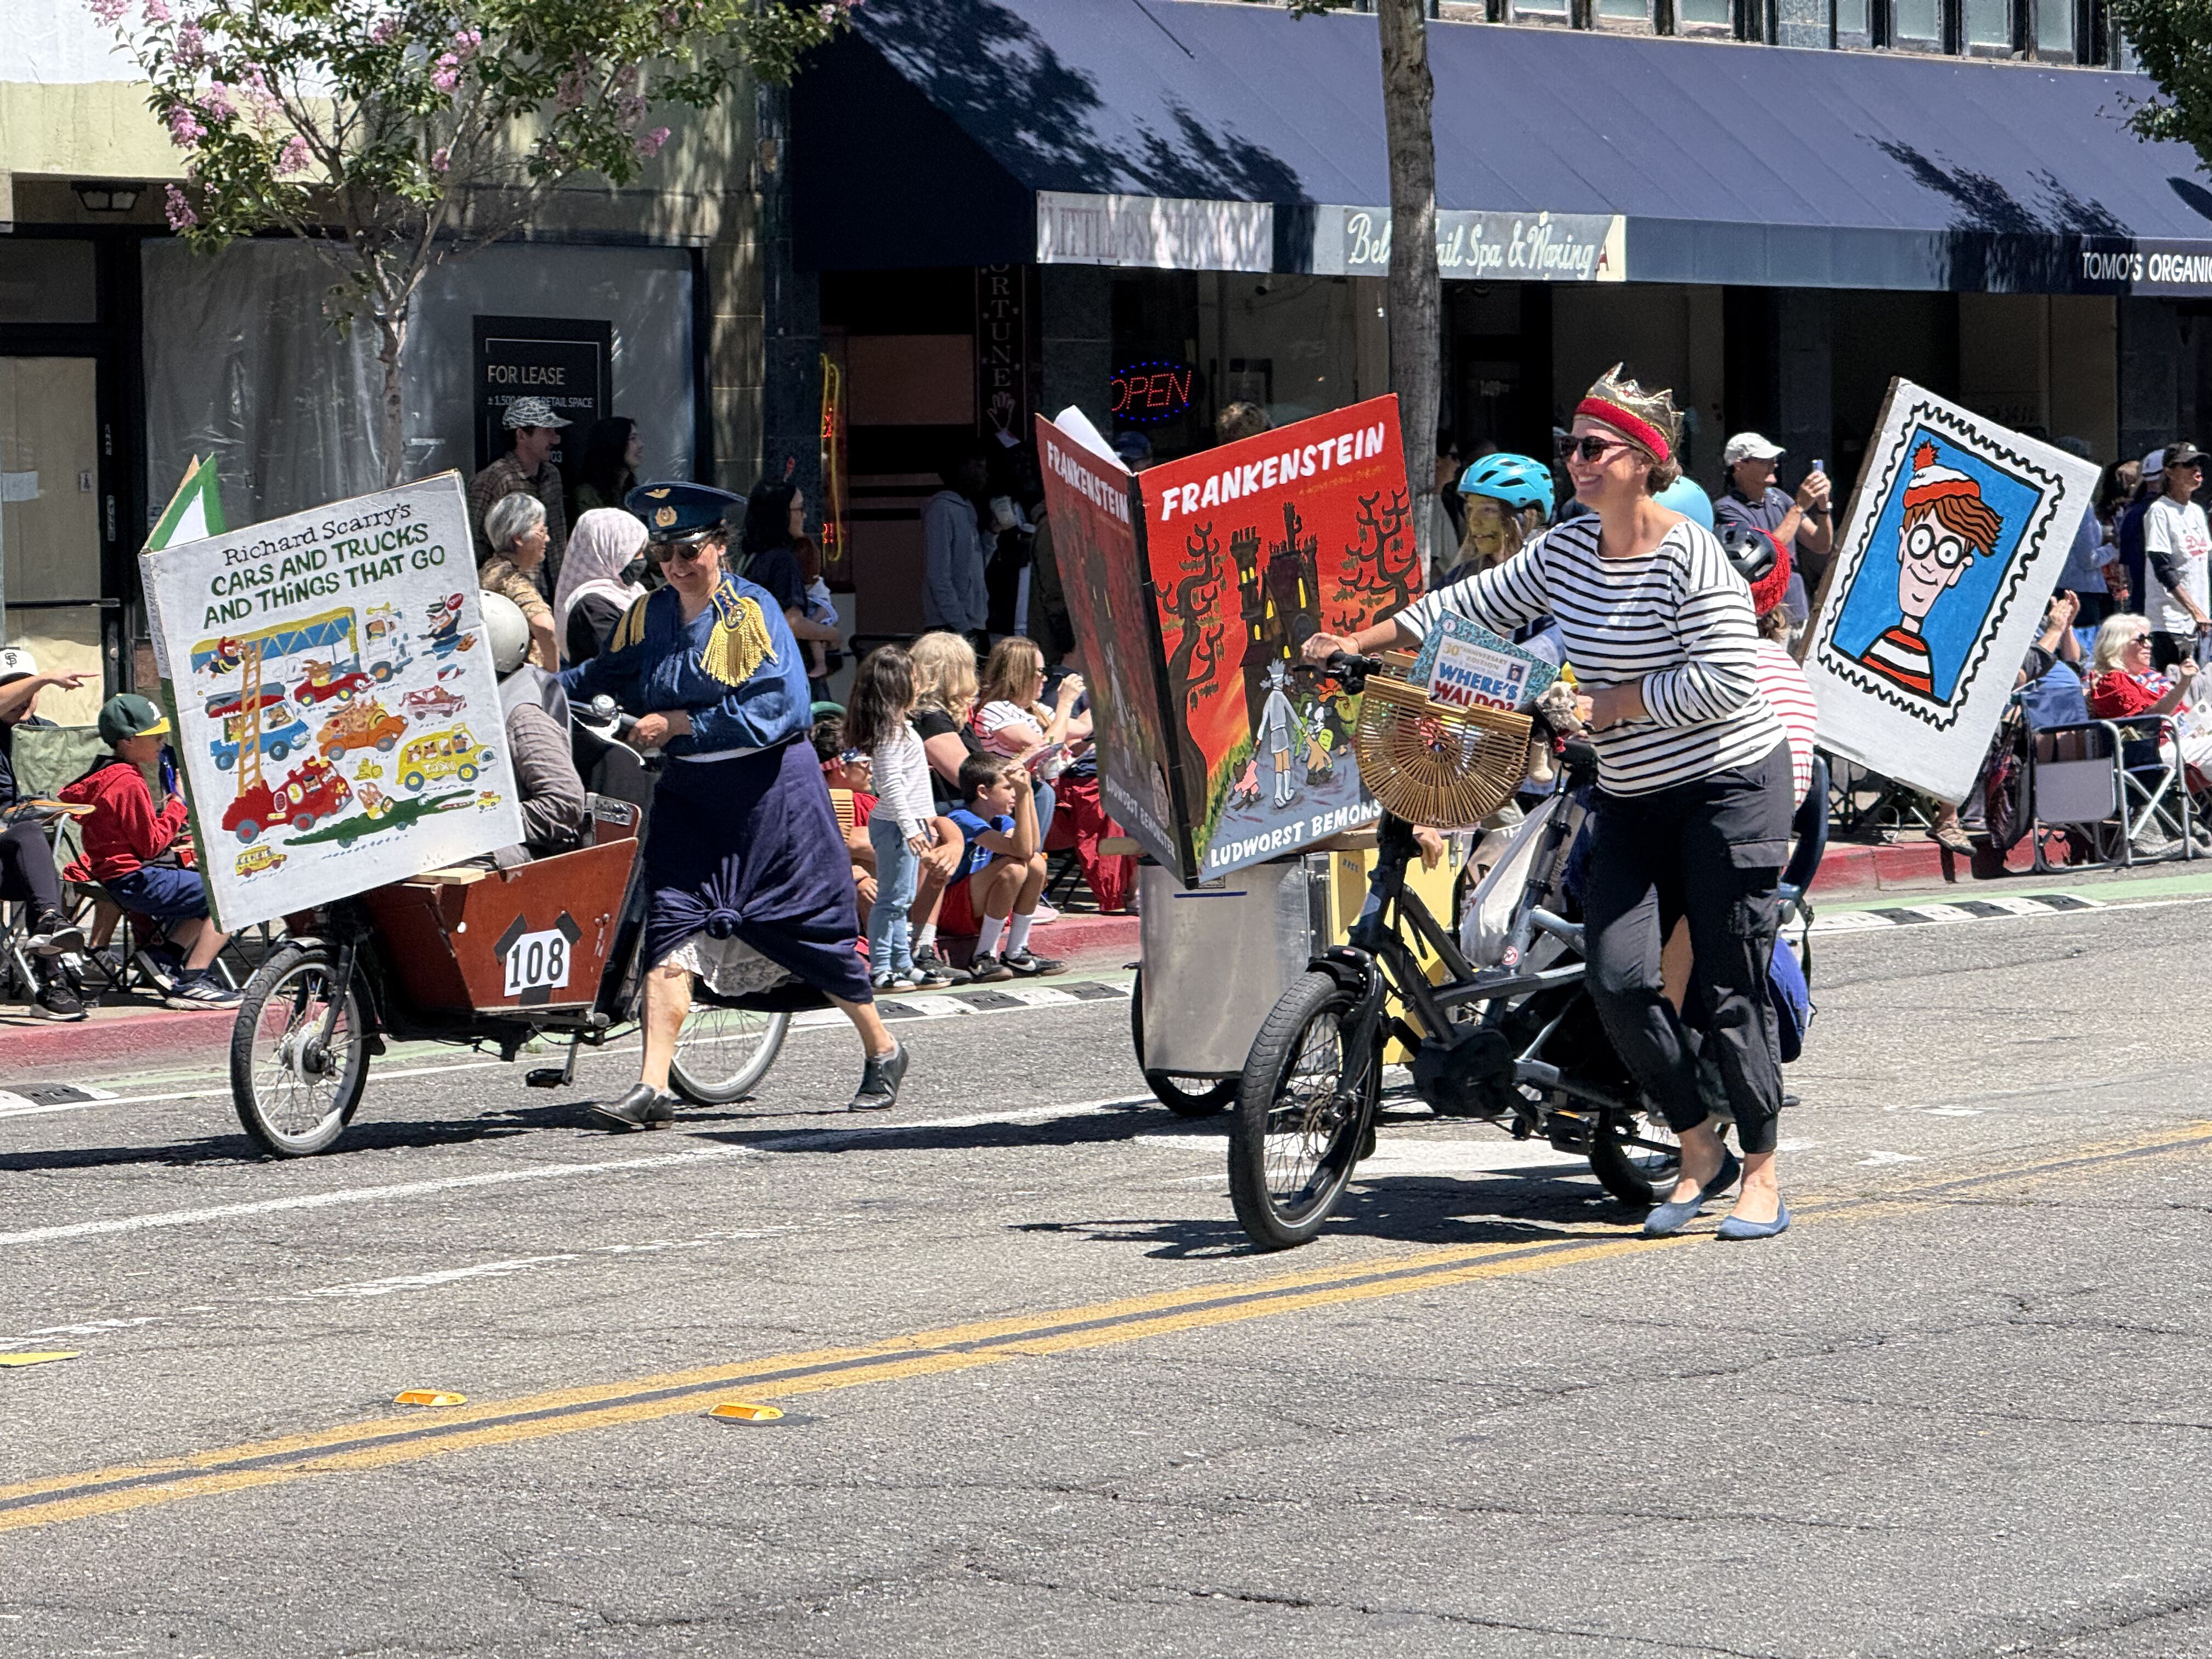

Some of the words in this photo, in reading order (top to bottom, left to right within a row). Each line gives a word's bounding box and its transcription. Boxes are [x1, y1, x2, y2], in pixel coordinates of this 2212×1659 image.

[1347, 213, 1391, 264] Bel
[1466, 223, 1503, 276] Spa
[1508, 220, 1526, 268] &
[1527, 224, 1595, 280] Waxing
[2083, 252, 2143, 281] TOMO'S
[487, 365, 518, 383] FOR
[521, 366, 566, 385] LEASE
[568, 397, 594, 408] SPACE
[1111, 370, 1192, 411] OPEN
[1047, 439, 1130, 524] FRANKENSTEIN
[1161, 421, 1385, 521] FRANKENSTEIN
[211, 563, 274, 596] CARS
[279, 549, 328, 582] AND
[330, 523, 429, 563] TRUCKS
[222, 526, 319, 566] Richard
[321, 503, 411, 540] Scarry's
[203, 598, 252, 630] AND
[343, 554, 405, 588] THAT
[411, 545, 445, 570] GO
[1439, 662, 1519, 700] WHERE'S
[422, 760, 457, 776] TAXI
[1210, 821, 1305, 868] LUDWORST
[1311, 799, 1384, 837] BEMONS
[510, 937, 564, 988] 108
